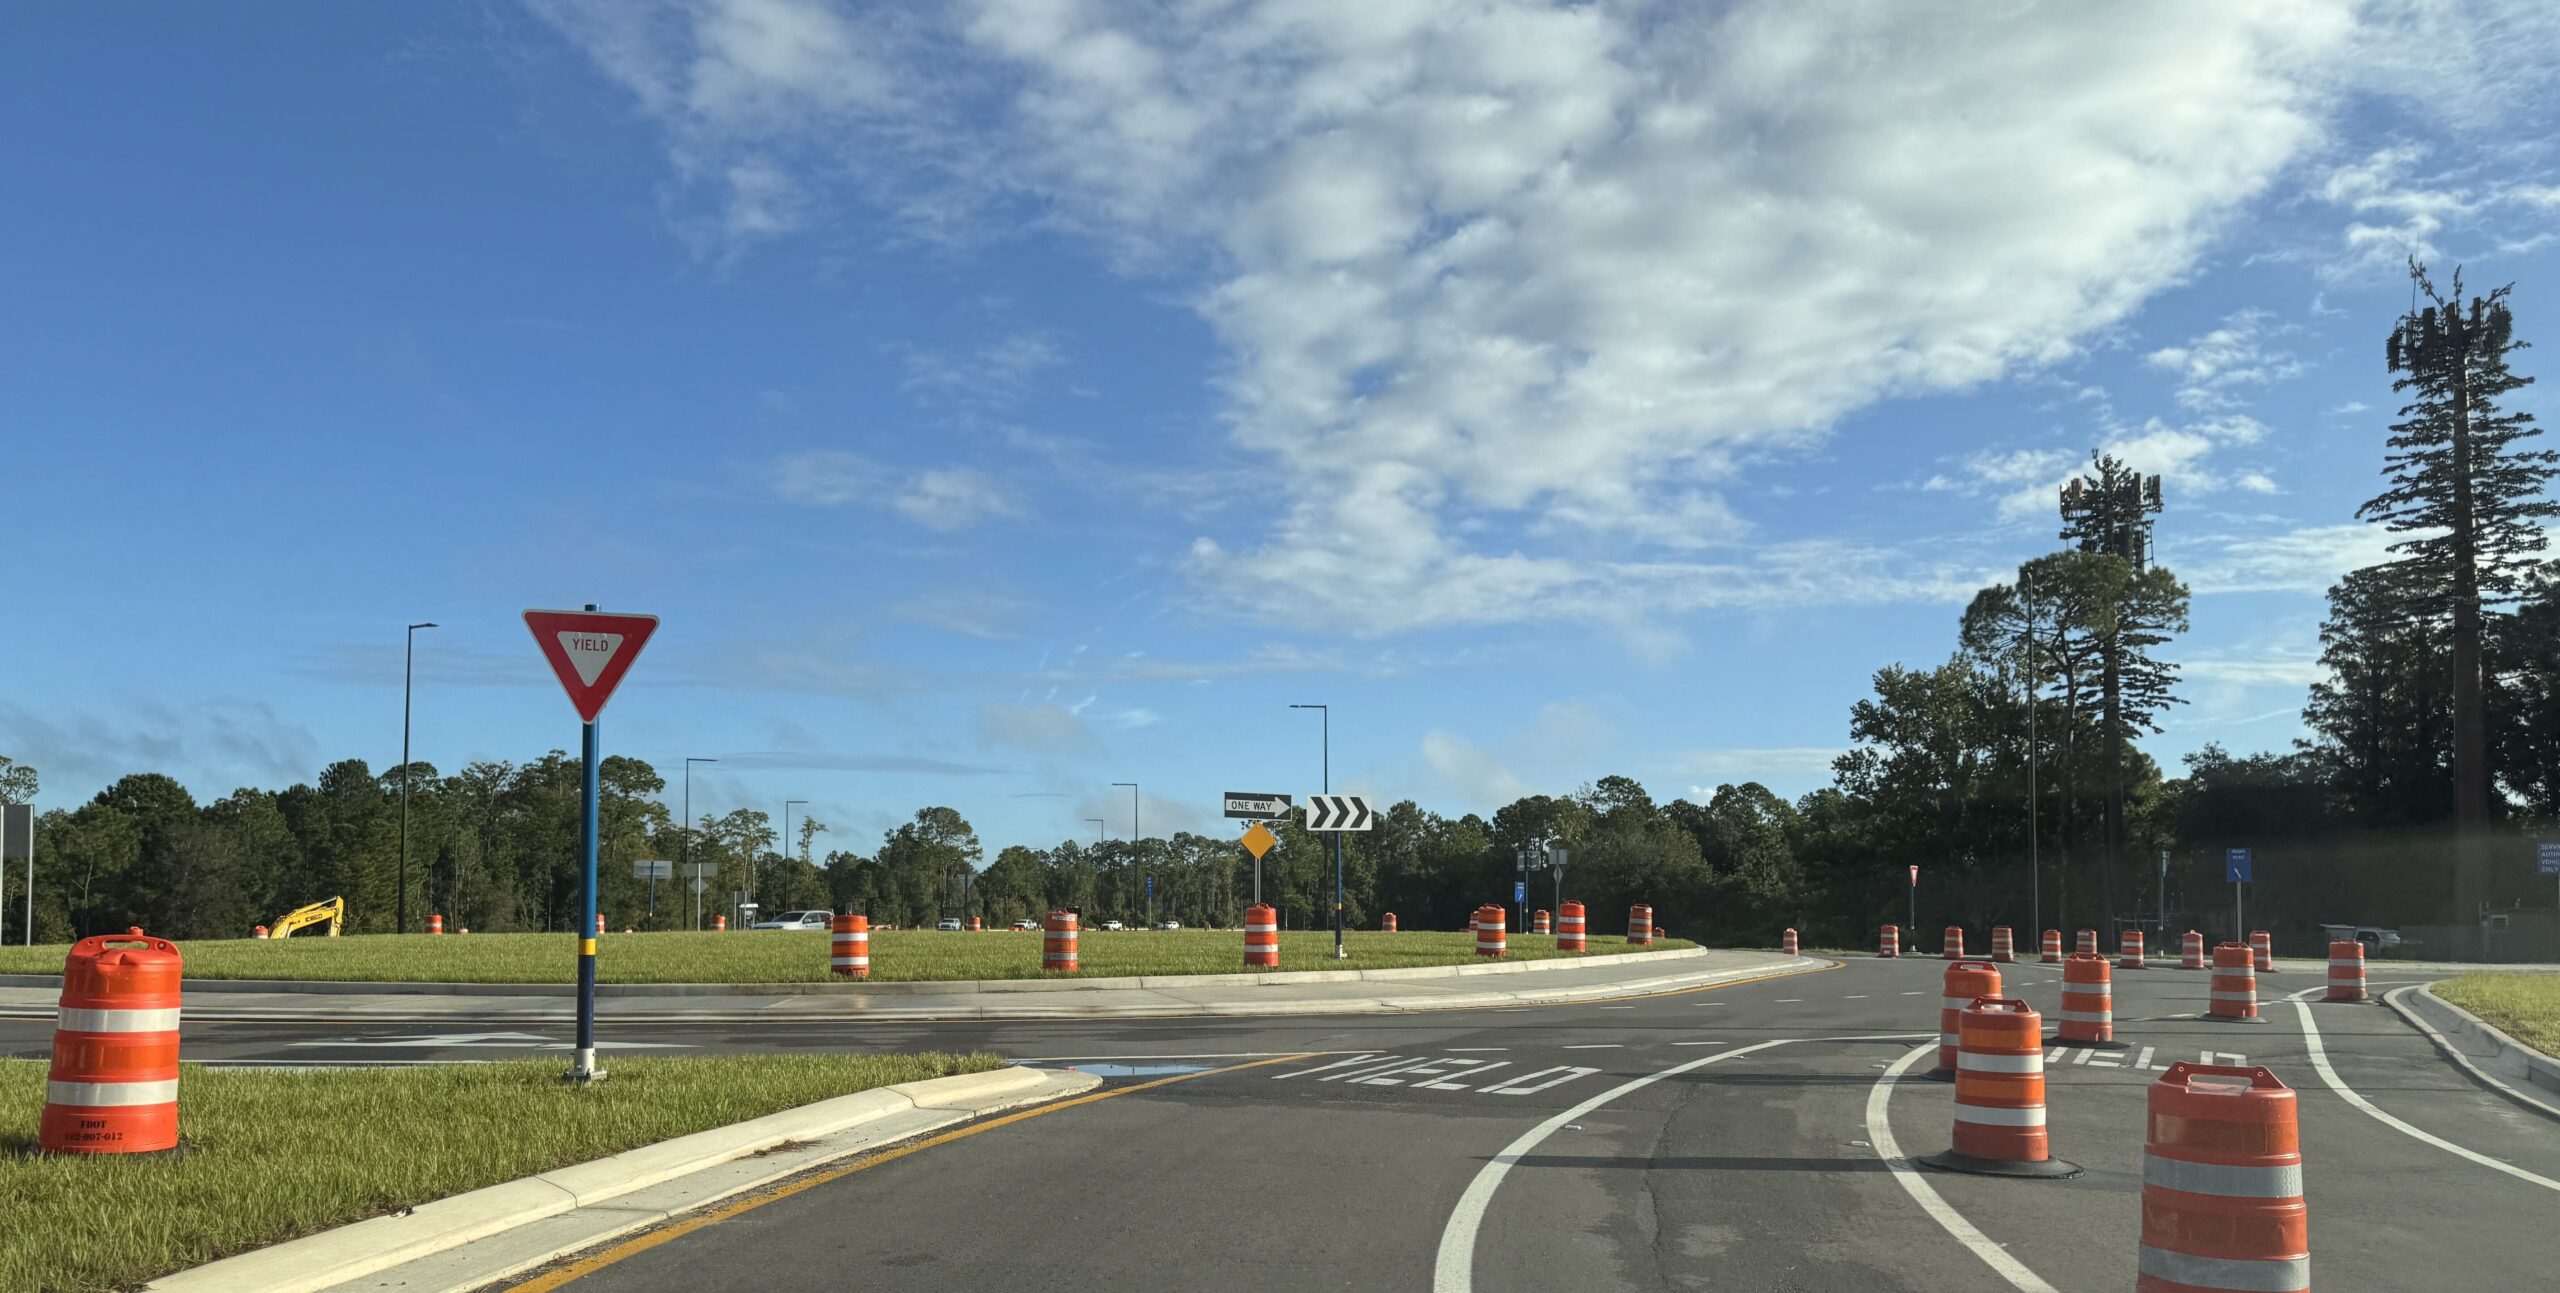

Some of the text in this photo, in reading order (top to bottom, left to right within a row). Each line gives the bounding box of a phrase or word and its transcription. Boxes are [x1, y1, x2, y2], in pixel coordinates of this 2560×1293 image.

[572, 638, 609, 652] YIELD
[1231, 801, 1273, 811] ONE WAY
[1270, 1054, 1603, 1095] YIELD
[80, 1120, 107, 1129] FDOT
